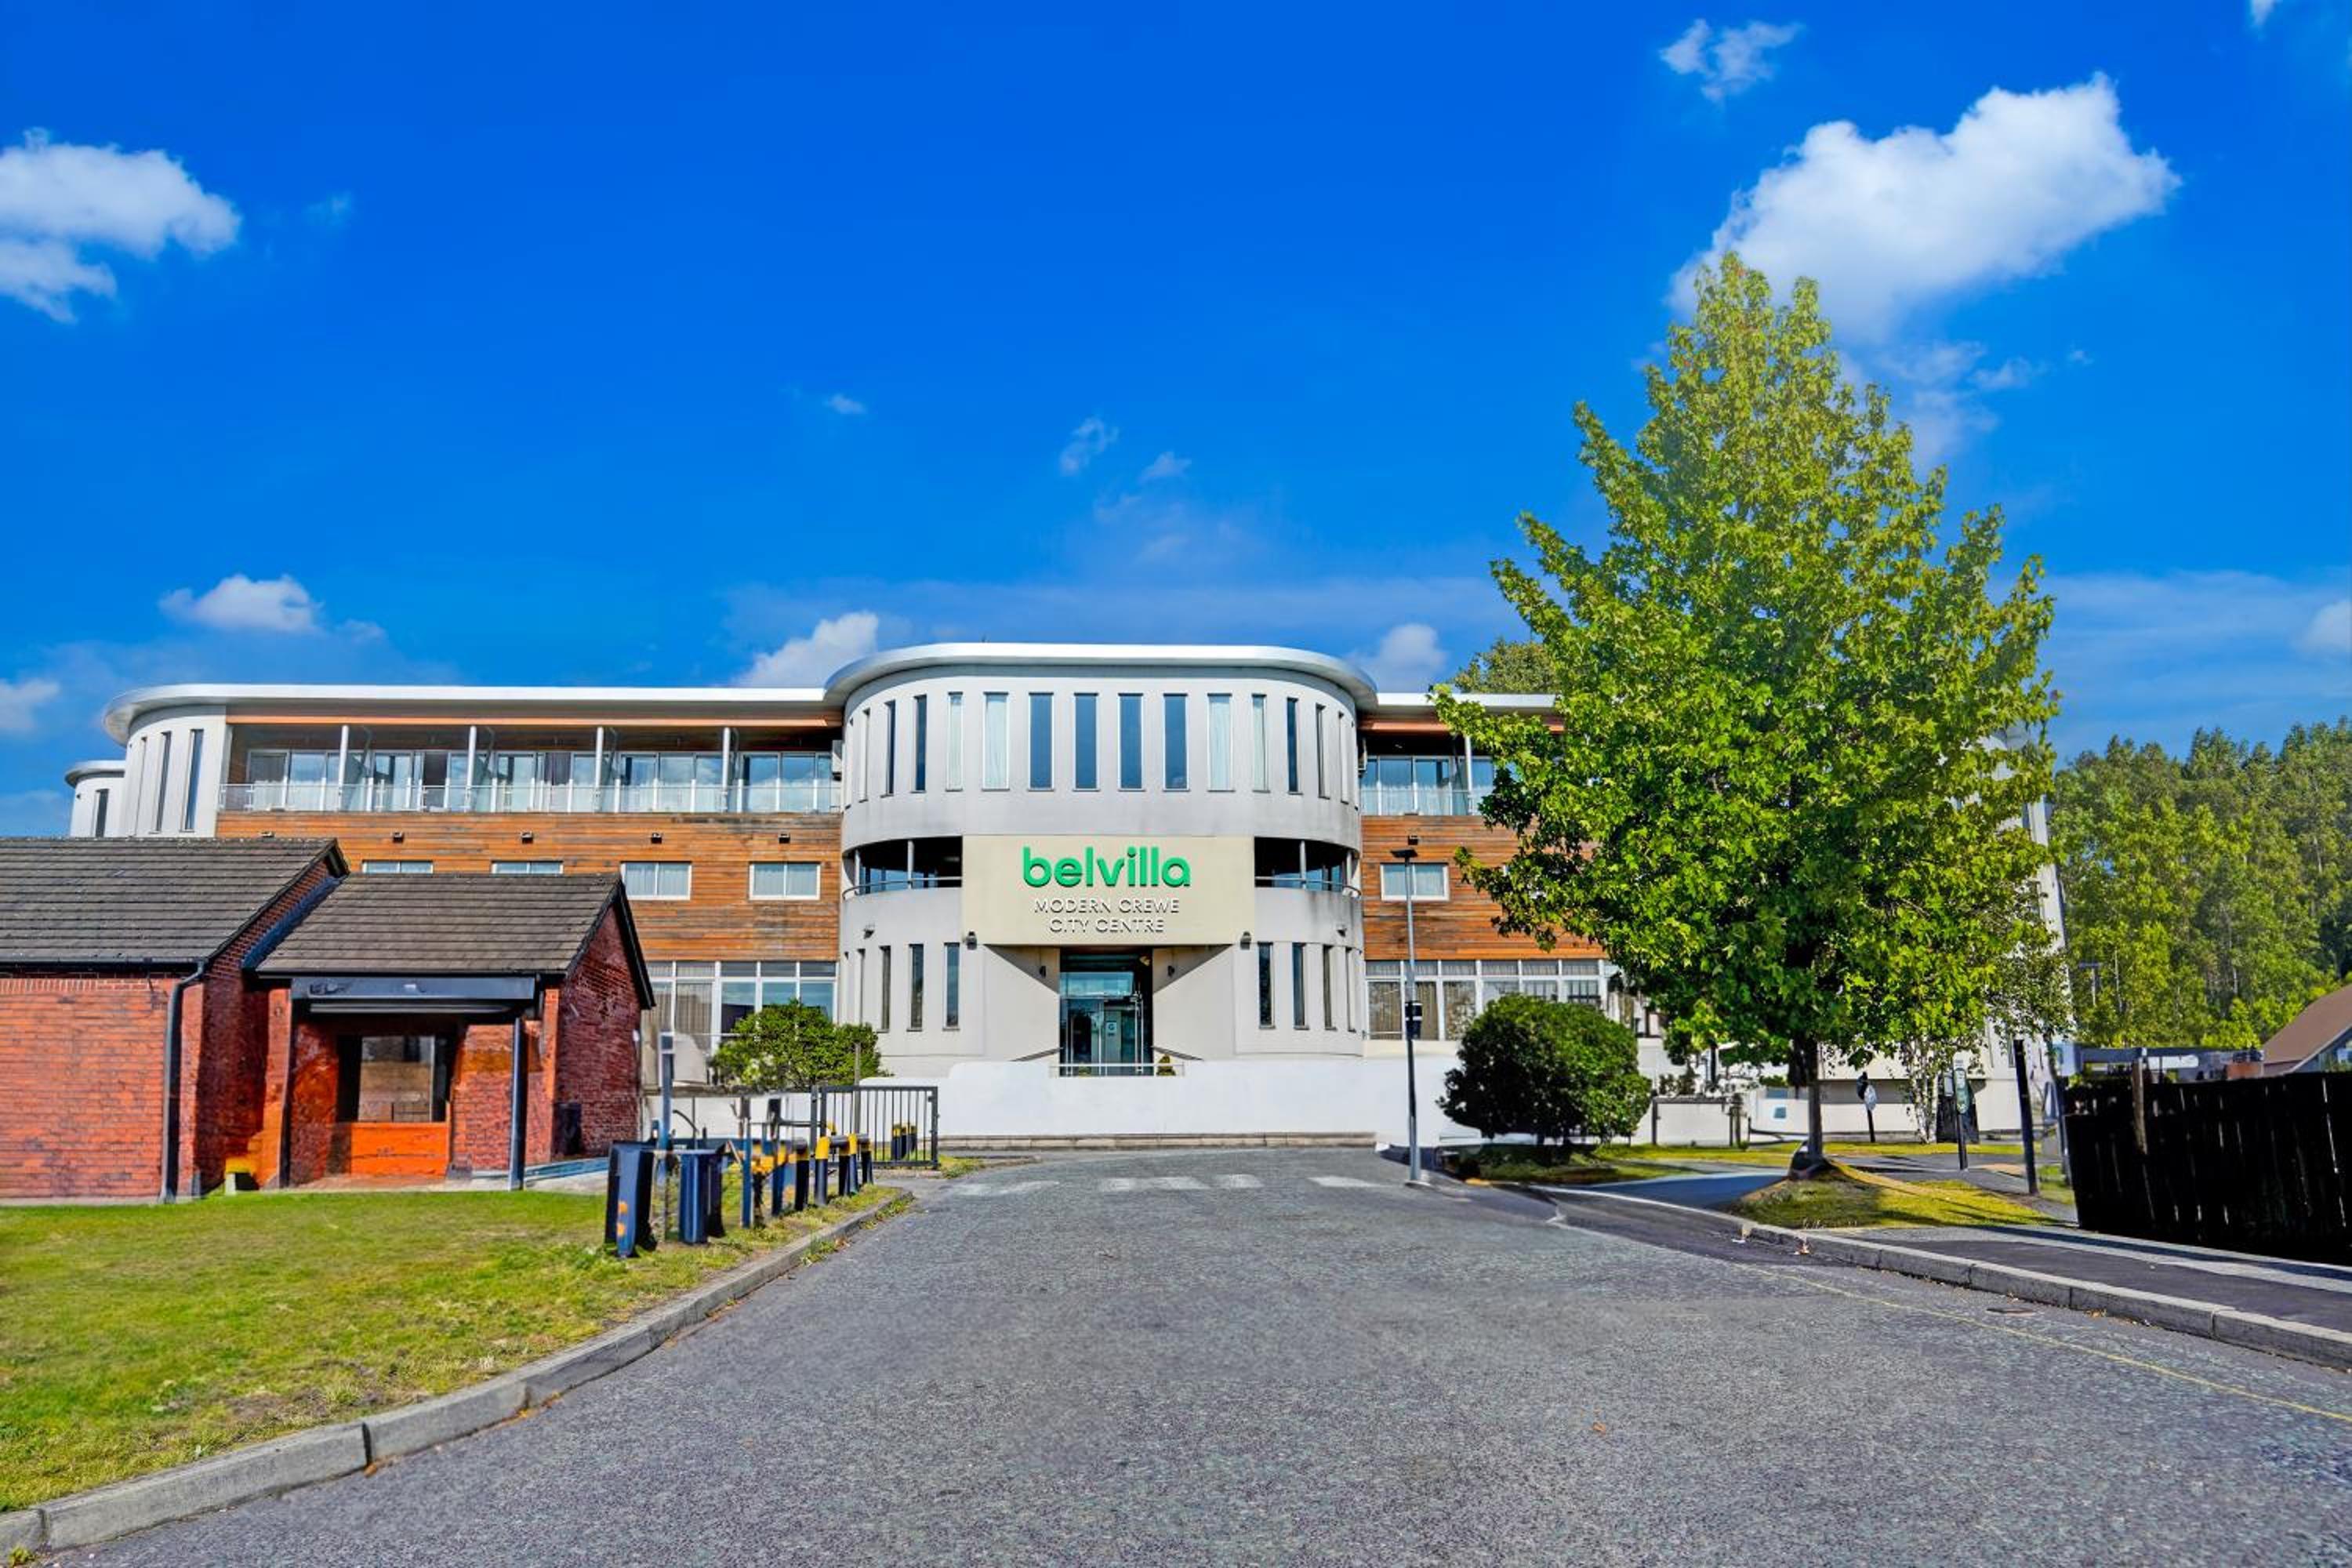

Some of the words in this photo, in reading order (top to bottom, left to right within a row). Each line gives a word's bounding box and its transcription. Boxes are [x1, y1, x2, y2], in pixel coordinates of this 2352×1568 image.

[1023, 846, 1191, 887] belvilla
[1034, 898, 1111, 913] MODERN
[1119, 898, 1179, 913] CREWE
[1050, 918, 1089, 933] CITY
[1095, 918, 1164, 933] CENTRE
